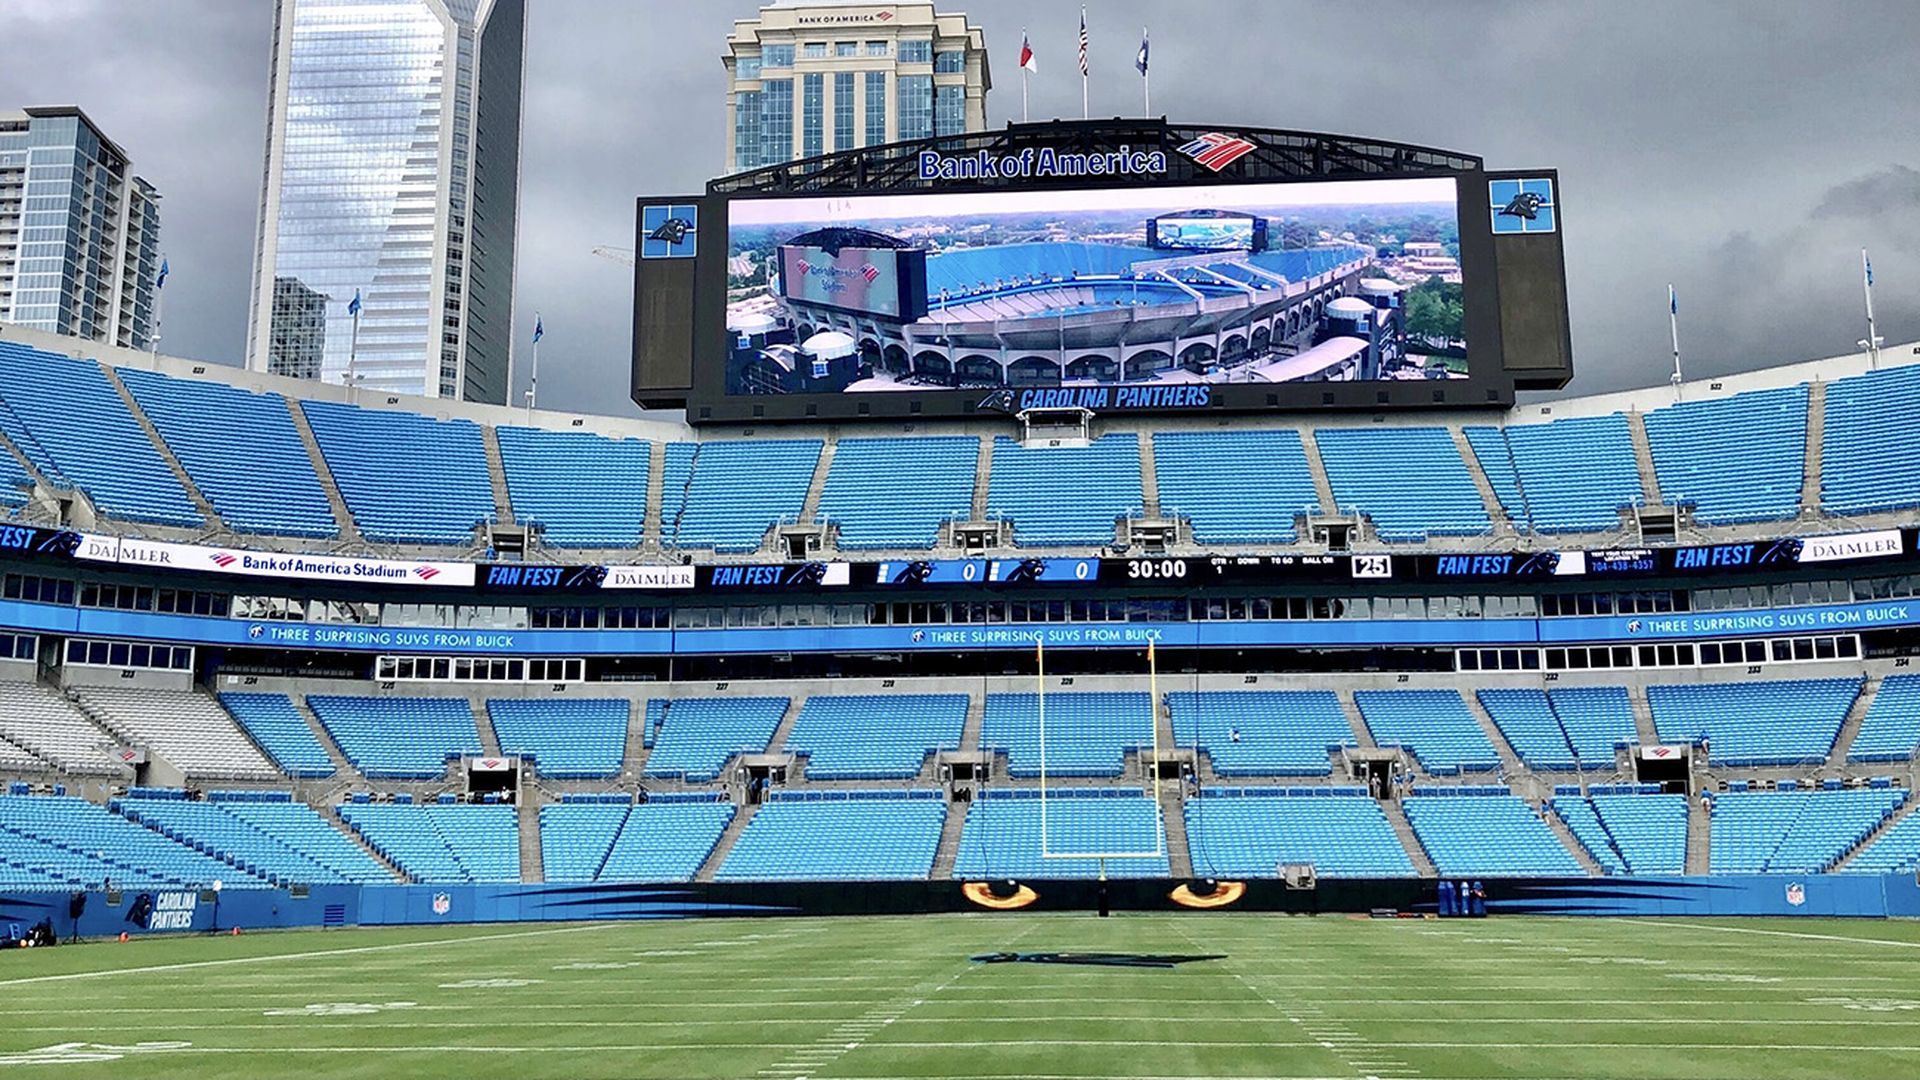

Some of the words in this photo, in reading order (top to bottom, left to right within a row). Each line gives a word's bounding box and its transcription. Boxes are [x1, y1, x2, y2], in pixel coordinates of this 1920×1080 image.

[918, 149, 998, 180] Bank
[1000, 147, 1033, 178] of
[1035, 144, 1167, 176] America
[1020, 387, 1108, 409] CAROLINA
[1114, 385, 1211, 408] PANTHERS
[88, 543, 172, 564] DAIMLER
[1674, 547, 1709, 568] FAN
[1711, 544, 1756, 566] FEST
[1812, 538, 1900, 558] DAIMLER
[243, 555, 277, 570] Bank
[279, 558, 294, 571] of
[295, 559, 351, 576] America
[353, 562, 408, 578] Stadium
[1076, 561, 1088, 579] 0
[1127, 560, 1187, 578] 30:00
[1216, 565, 1222, 574] 1
[1302, 556, 1321, 564] BALL
[1360, 557, 1385, 575] 25
[1436, 556, 1469, 575] FAN
[1471, 555, 1513, 574] FEST
[487, 566, 521, 585] FAN
[522, 567, 564, 586] FEST
[614, 573, 692, 585] DAIMLER
[711, 566, 744, 586] FAN
[745, 566, 785, 585] FEST
[962, 563, 976, 581] 0
[1648, 619, 1688, 633] THREE
[1693, 615, 1774, 631] SURPRISING
[1779, 612, 1815, 627] SUVS
[1820, 609, 1861, 624] FROM
[1866, 606, 1909, 622] BUICK
[270, 627, 310, 641] THREE
[314, 629, 391, 645] SURPRISING
[396, 632, 430, 646] SUVS
[434, 633, 471, 647] FROM
[476, 634, 514, 648] BUICK
[931, 631, 967, 643] THREE
[971, 630, 1045, 643] SURPRISING
[1049, 629, 1081, 641] SUVS
[1085, 628, 1121, 640] FROM
[1124, 627, 1163, 640] BUICK
[156, 891, 197, 911] CAROLINA
[149, 910, 194, 929] PANTHERS
